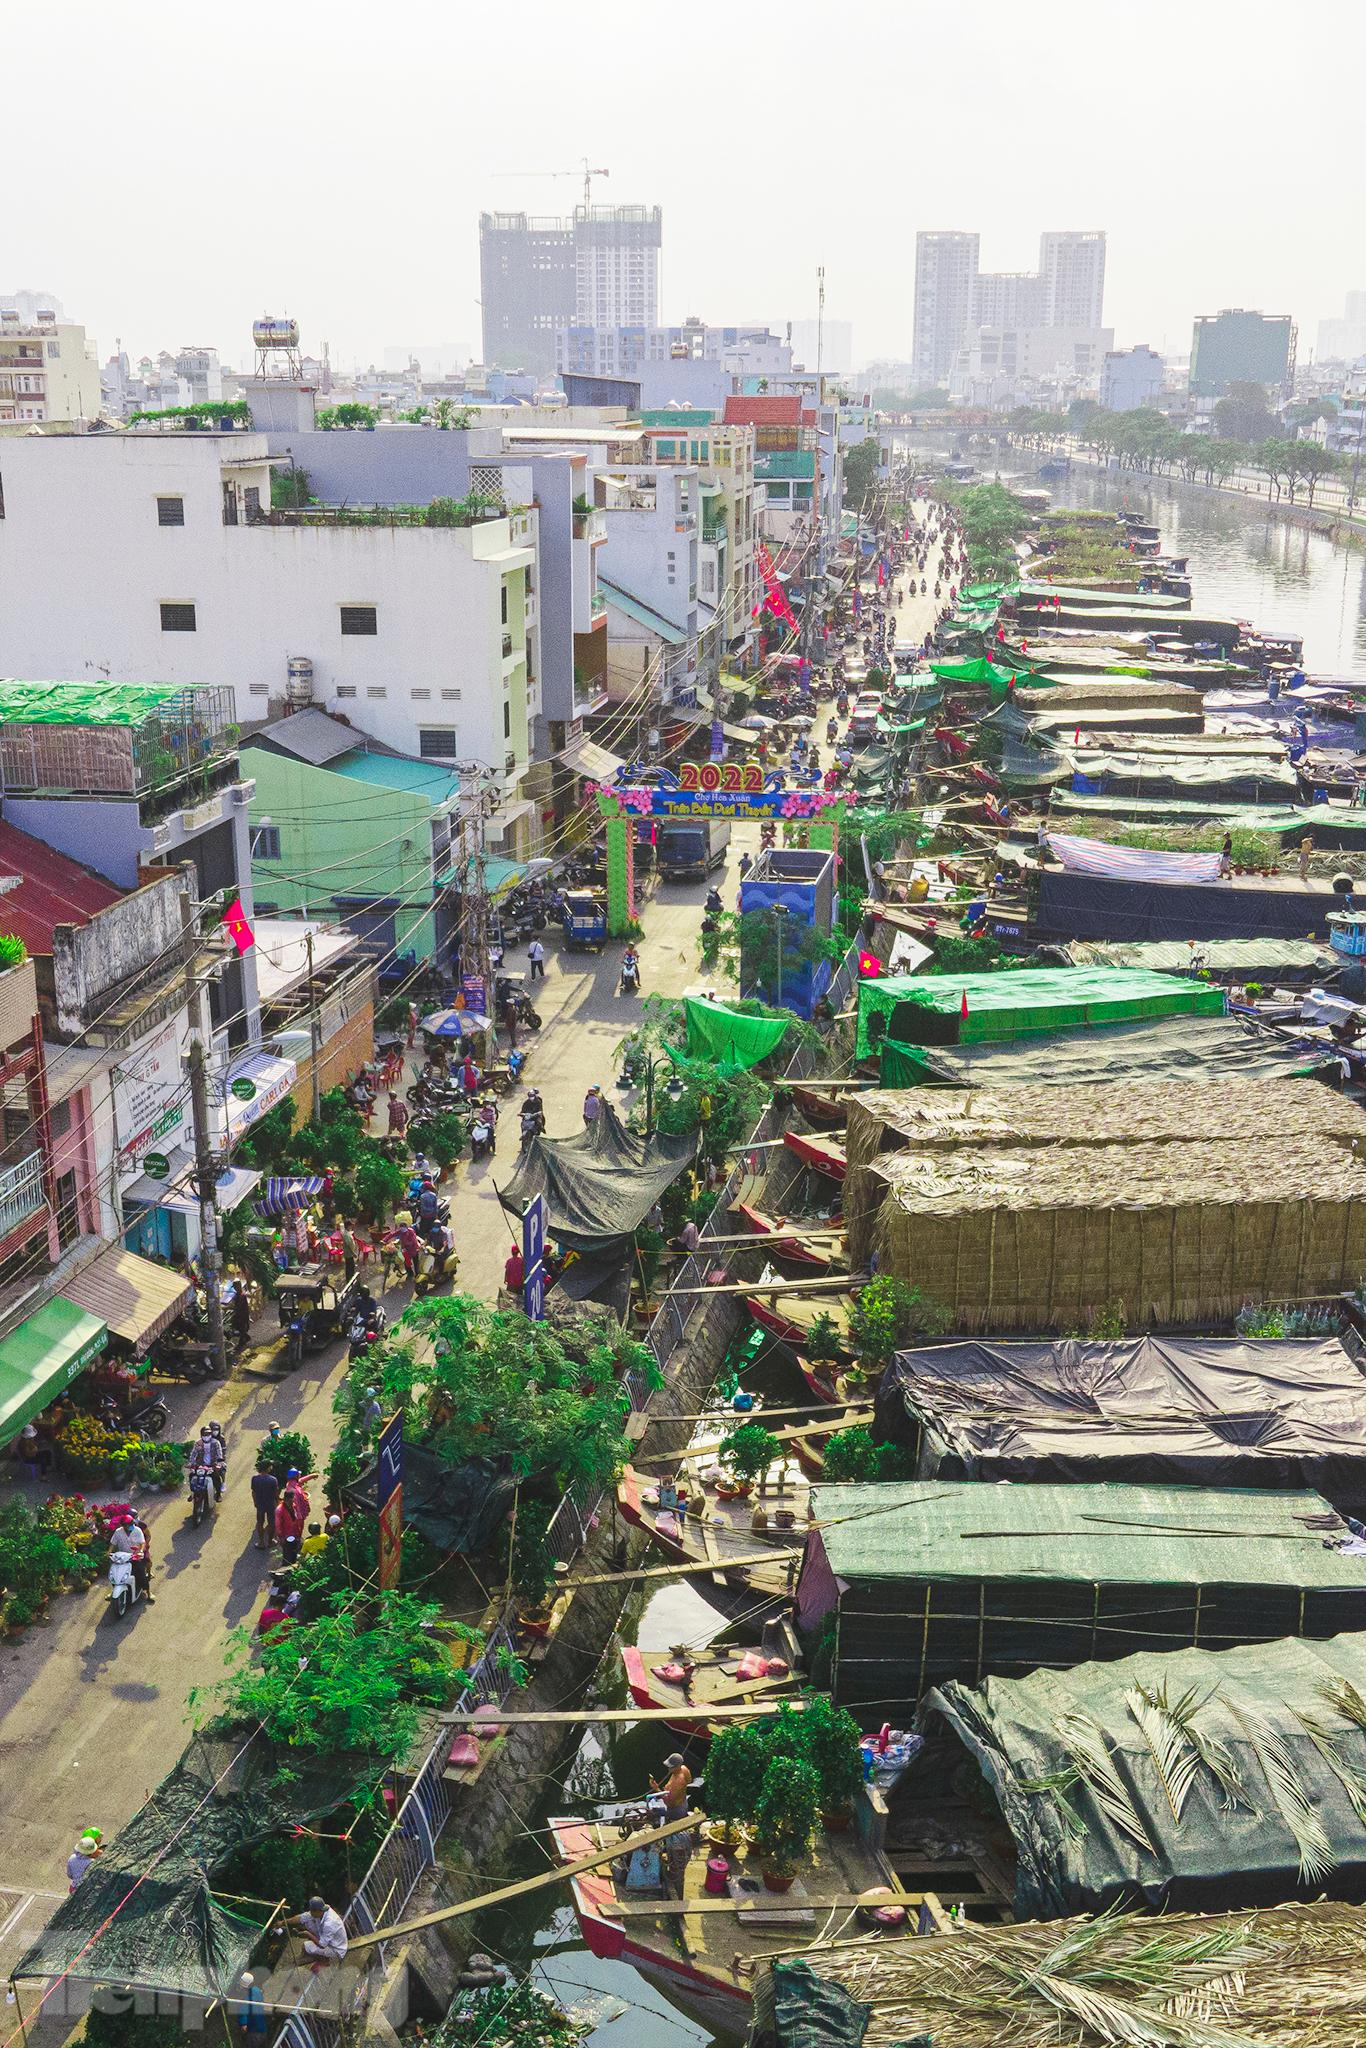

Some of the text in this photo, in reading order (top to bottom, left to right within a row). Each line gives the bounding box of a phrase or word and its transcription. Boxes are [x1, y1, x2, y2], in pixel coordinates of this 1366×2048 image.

[679, 762, 764, 792] 2022
[711, 793, 728, 802] Hoa
[530, 1213, 538, 1257] P
